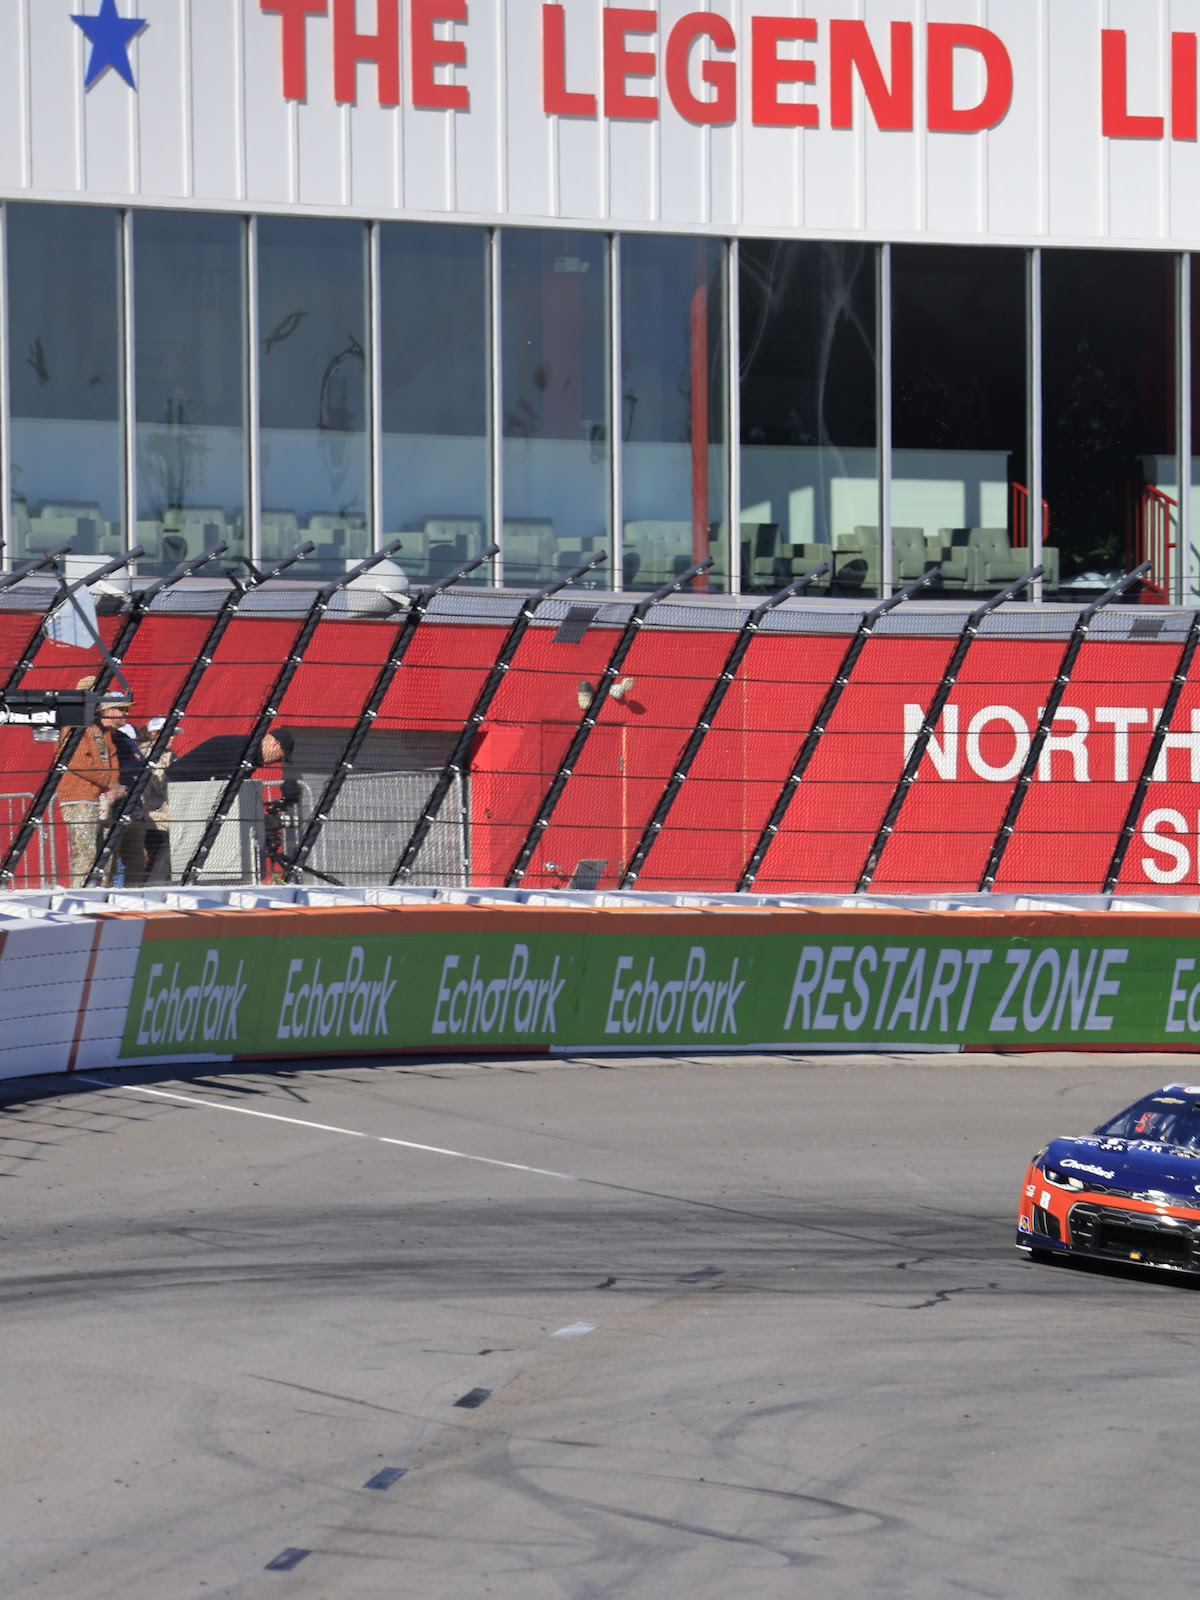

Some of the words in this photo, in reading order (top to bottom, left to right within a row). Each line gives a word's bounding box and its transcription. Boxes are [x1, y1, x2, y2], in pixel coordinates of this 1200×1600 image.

[260, 0, 469, 108] THE
[543, 4, 1012, 131] LEGEND
[136, 948, 248, 1046] EchoPark
[275, 945, 398, 1039] EchoPark
[431, 943, 567, 1035] EchoPark
[604, 946, 746, 1034] EchoPark
[783, 945, 993, 1032] RESTART
[989, 948, 1129, 1032] ZONE
[1039, 1190, 1052, 1209] 8
[1059, 1158, 1116, 1180] Cheddar's
